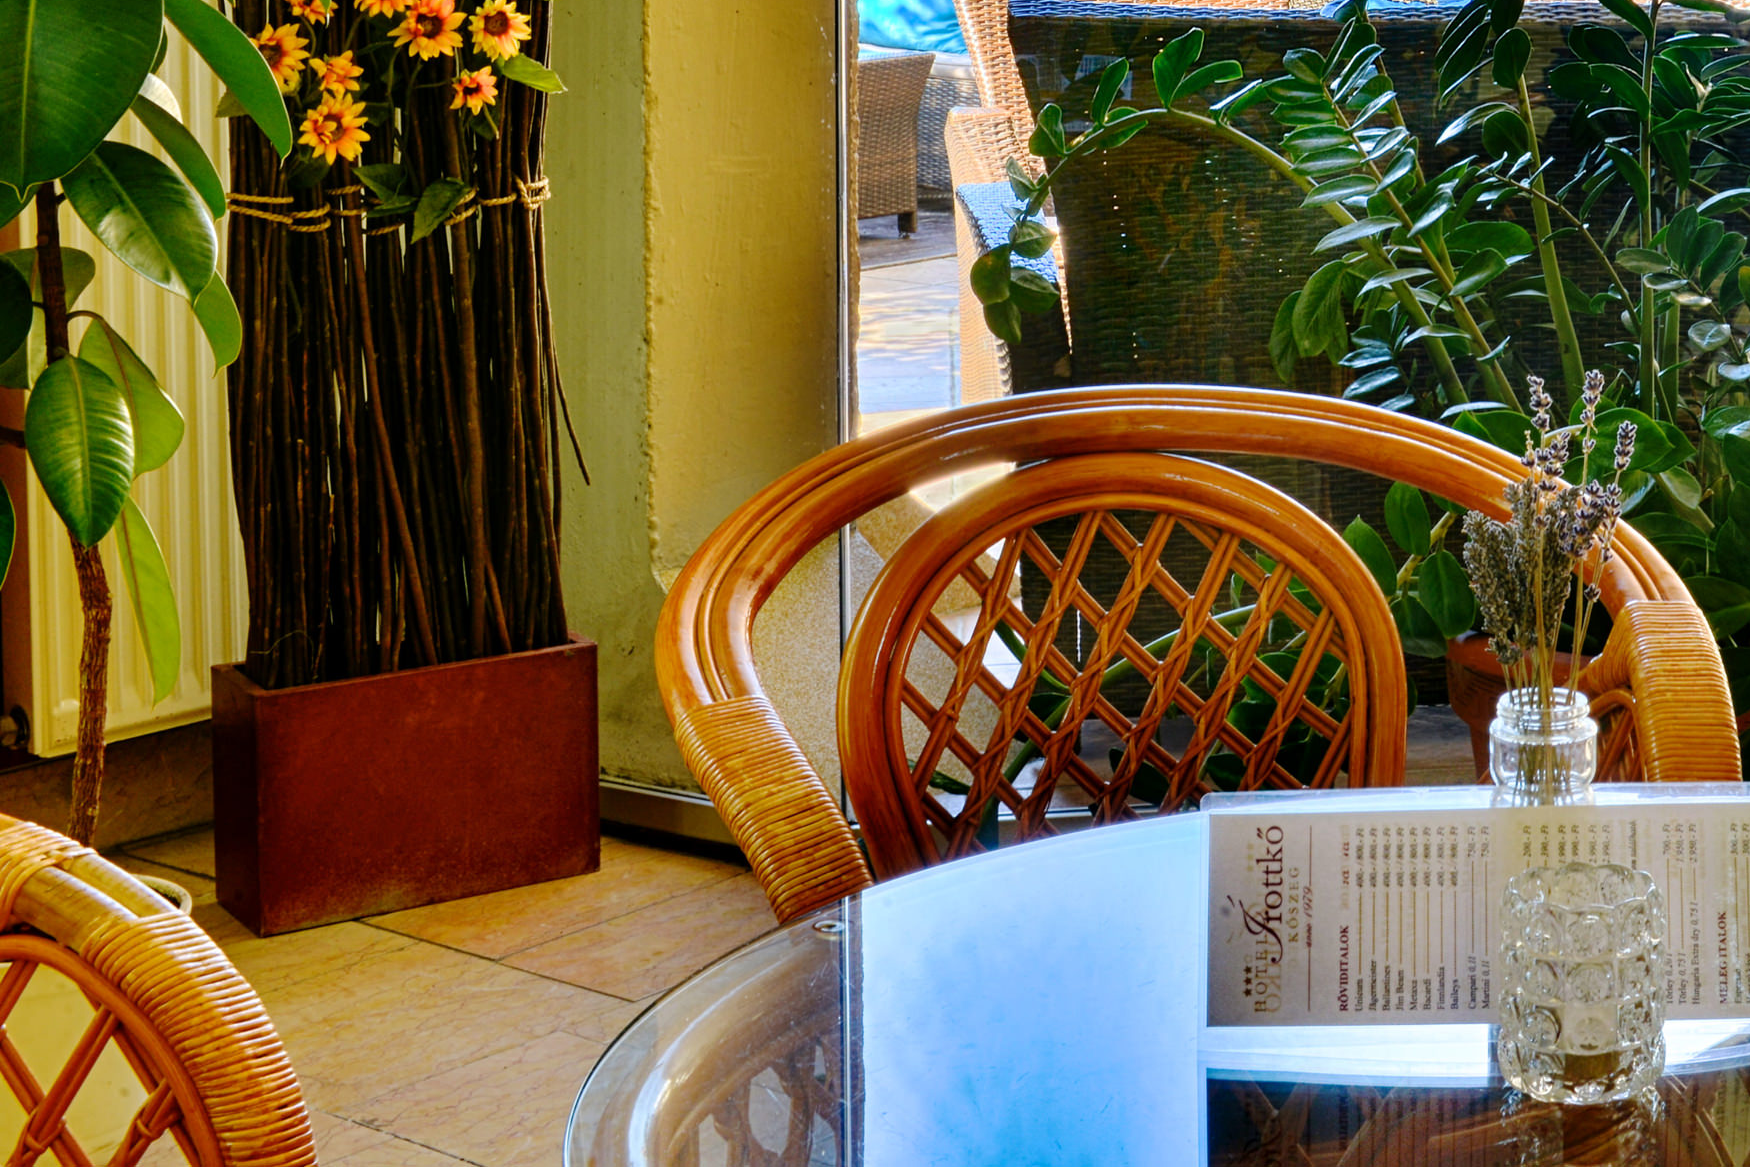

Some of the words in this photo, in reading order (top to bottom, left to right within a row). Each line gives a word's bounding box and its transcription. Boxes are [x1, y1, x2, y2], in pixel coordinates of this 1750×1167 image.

[1303, 886, 1313, 919] 1979
[1718, 912, 1727, 958] ITALOK
[1254, 935, 1268, 1013] HOTEL
[1337, 925, 1349, 1012] RÖVIDITALOK
[1719, 961, 1728, 1004] MELEG
